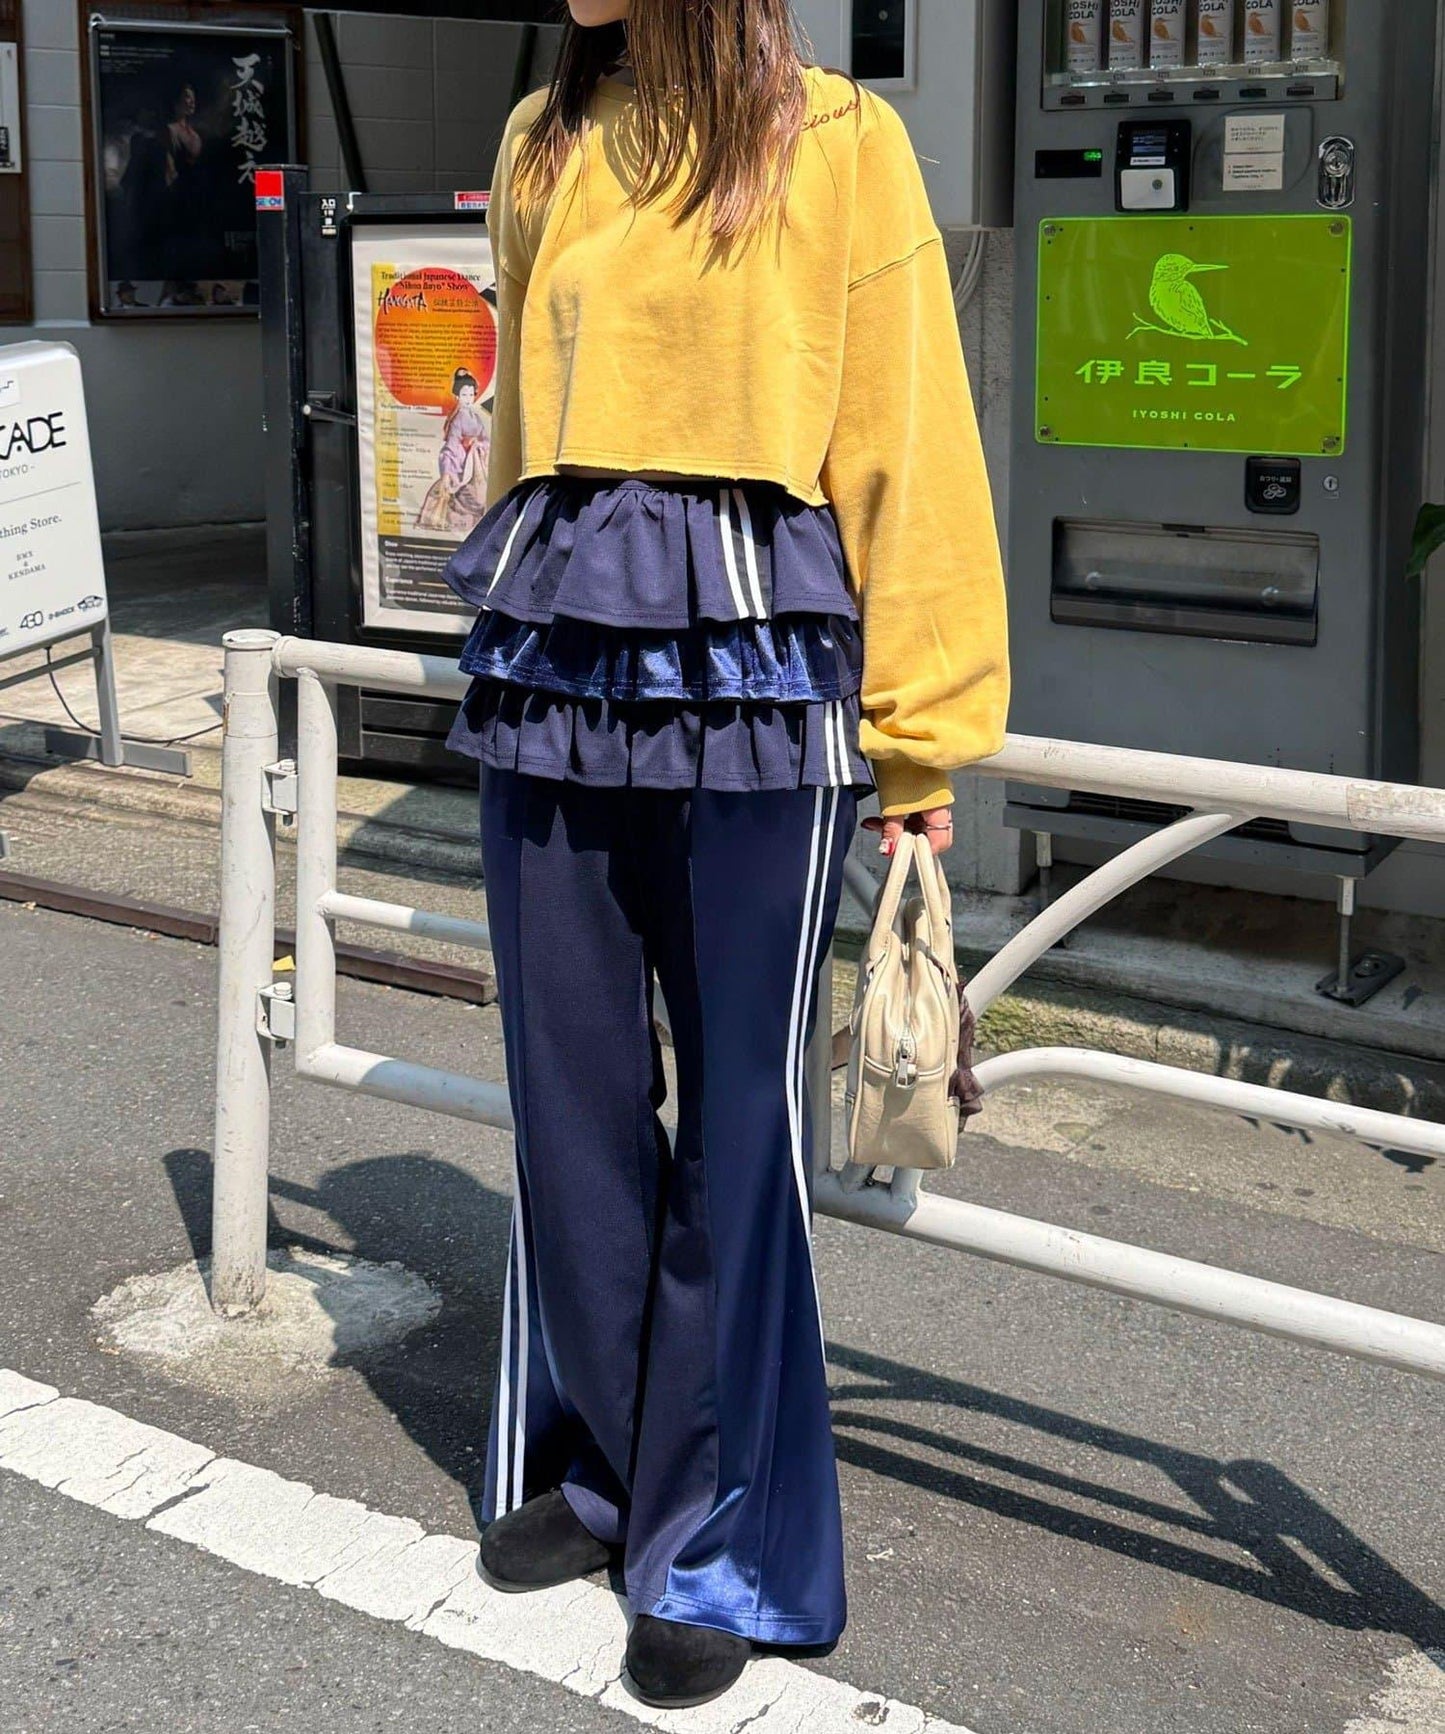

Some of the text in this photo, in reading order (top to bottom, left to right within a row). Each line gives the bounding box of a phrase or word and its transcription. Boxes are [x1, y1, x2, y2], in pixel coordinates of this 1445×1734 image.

[1075, 359, 1303, 390] 伊良コーラ
[1132, 409, 1237, 423] IYOSHI COLA
[30, 514, 63, 531] Store.
[8, 563, 46, 580] KENDAMA
